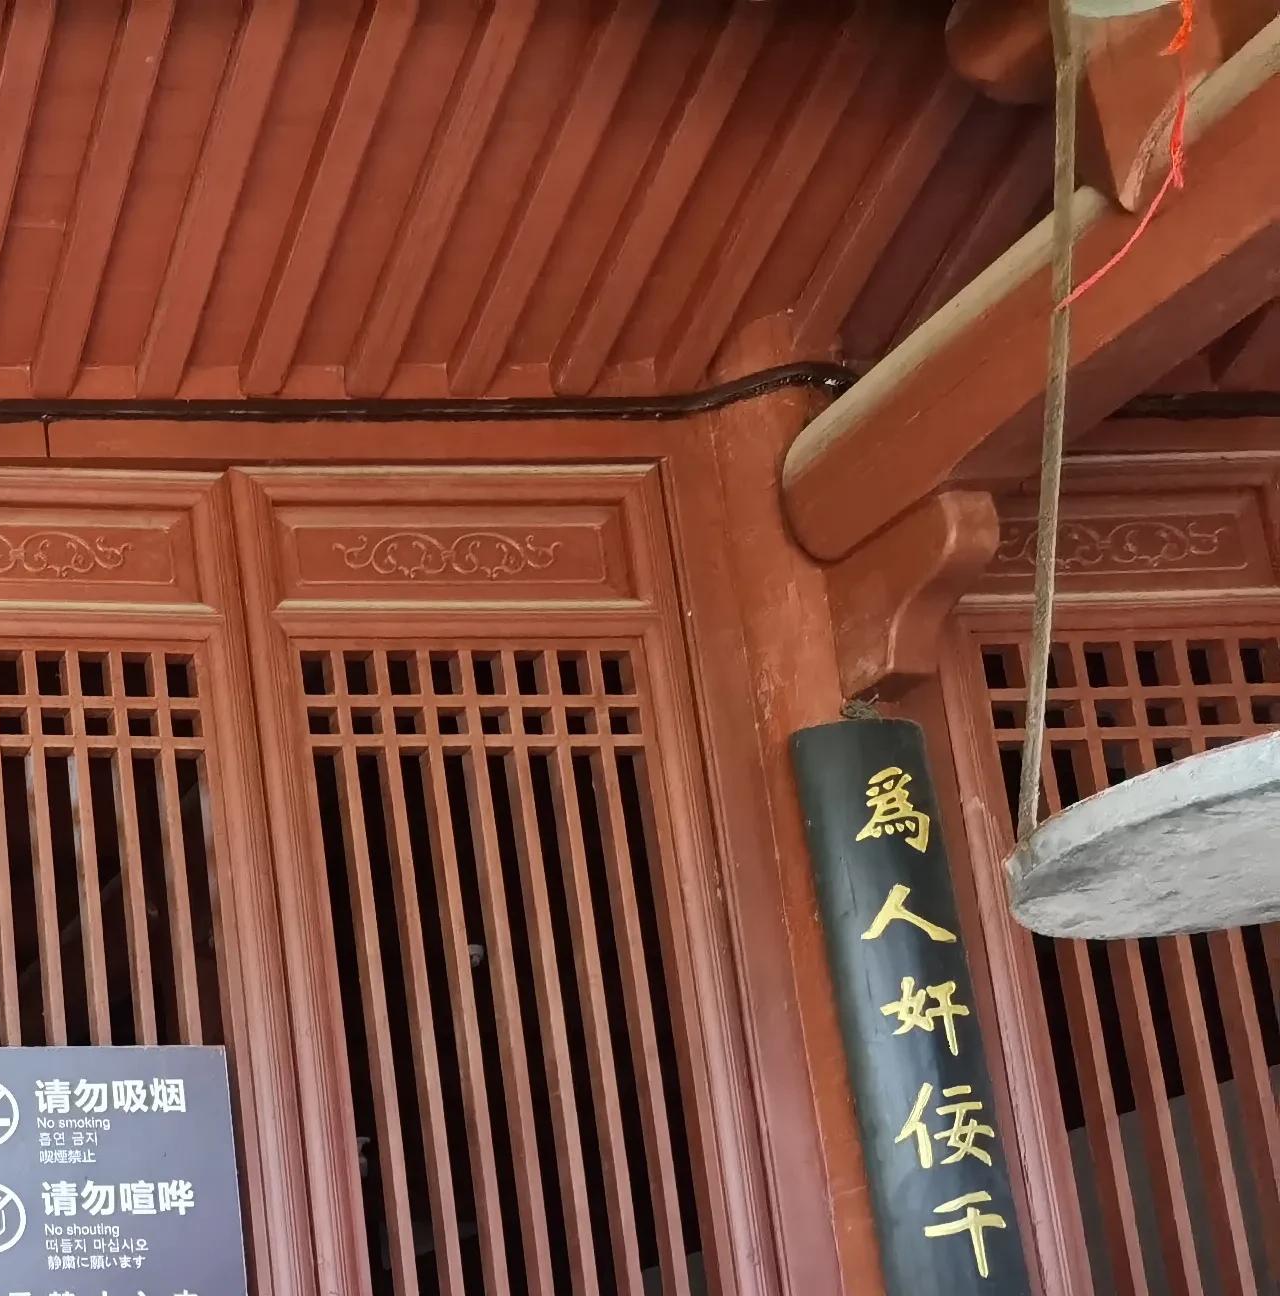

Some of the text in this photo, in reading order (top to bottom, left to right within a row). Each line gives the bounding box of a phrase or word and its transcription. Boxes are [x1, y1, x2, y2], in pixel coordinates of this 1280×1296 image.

[35, 1078, 186, 1113] 请勿吸烟
[37, 1117, 111, 1130] No smoking
[39, 1131, 98, 1146] 흡연 금지
[40, 1149, 96, 1164] 喫煙禁止
[42, 1180, 195, 1216] 请勿喧哗
[45, 1223, 120, 1237] No shouting
[46, 1238, 149, 1253] 떠들지 마십시오
